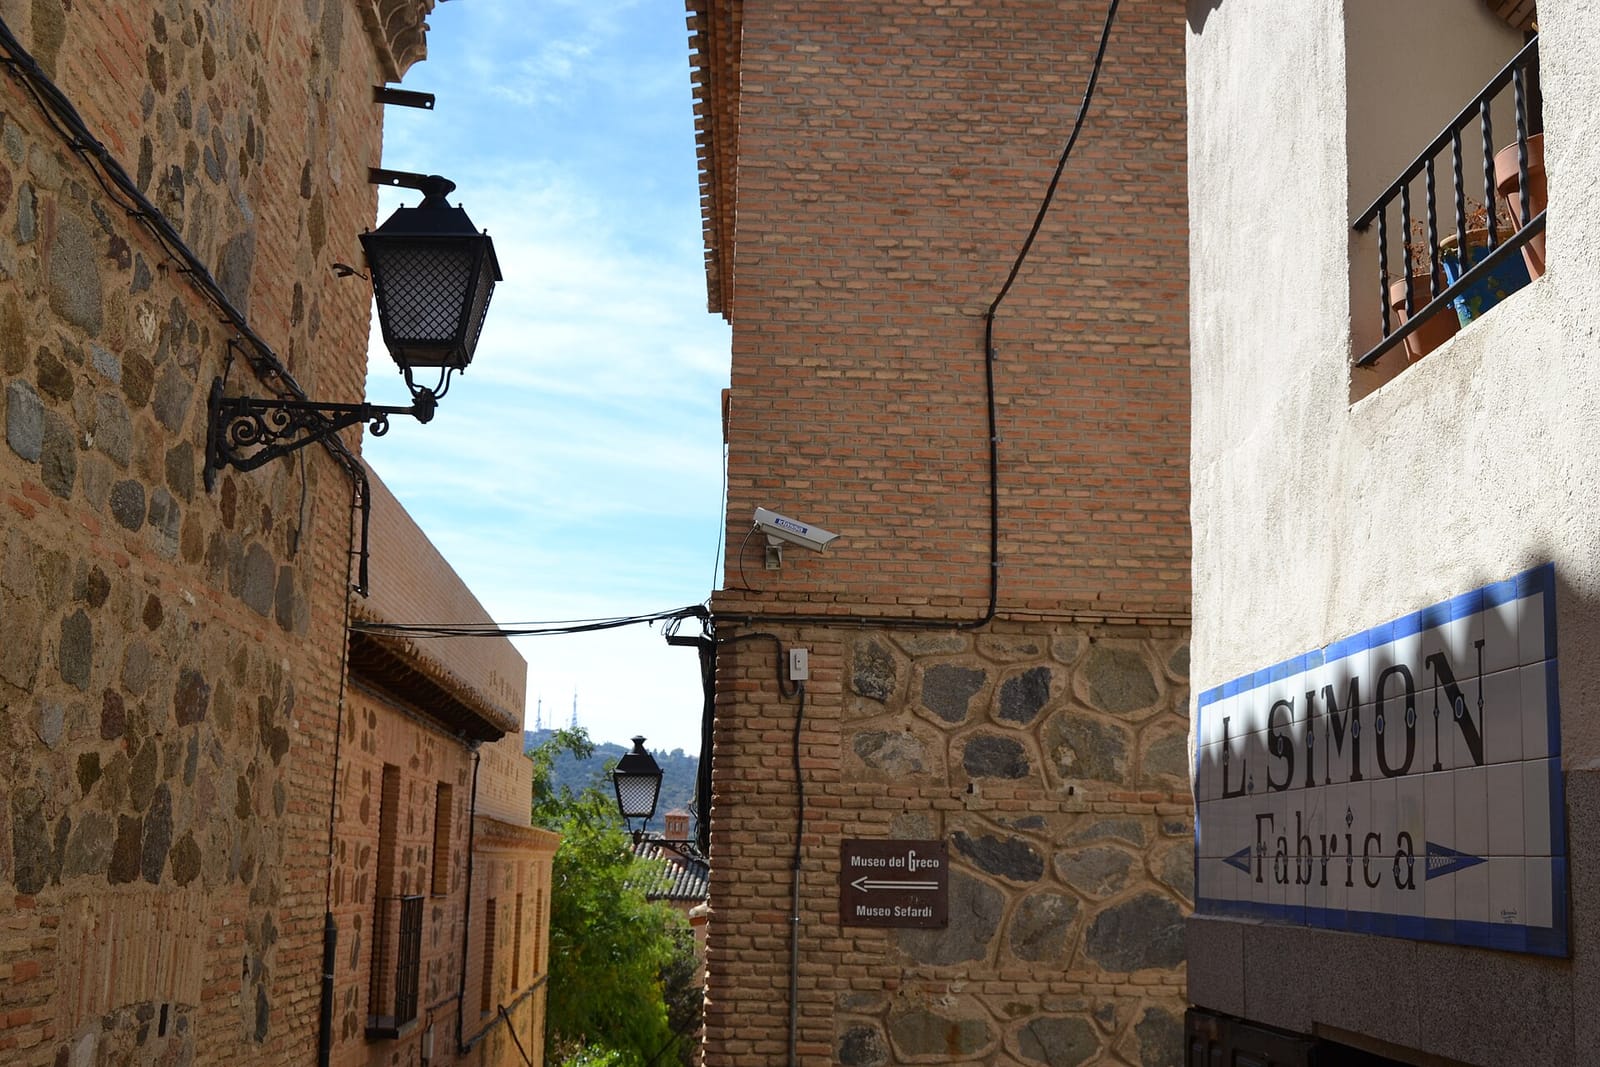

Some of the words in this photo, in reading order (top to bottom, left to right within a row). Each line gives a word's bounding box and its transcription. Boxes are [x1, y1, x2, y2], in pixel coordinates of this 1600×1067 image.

[1266, 639, 1486, 792] SIMON
[851, 855, 886, 867] Museo
[889, 856, 905, 867] del
[908, 850, 940, 872] Greco
[856, 905, 891, 916] Museo
